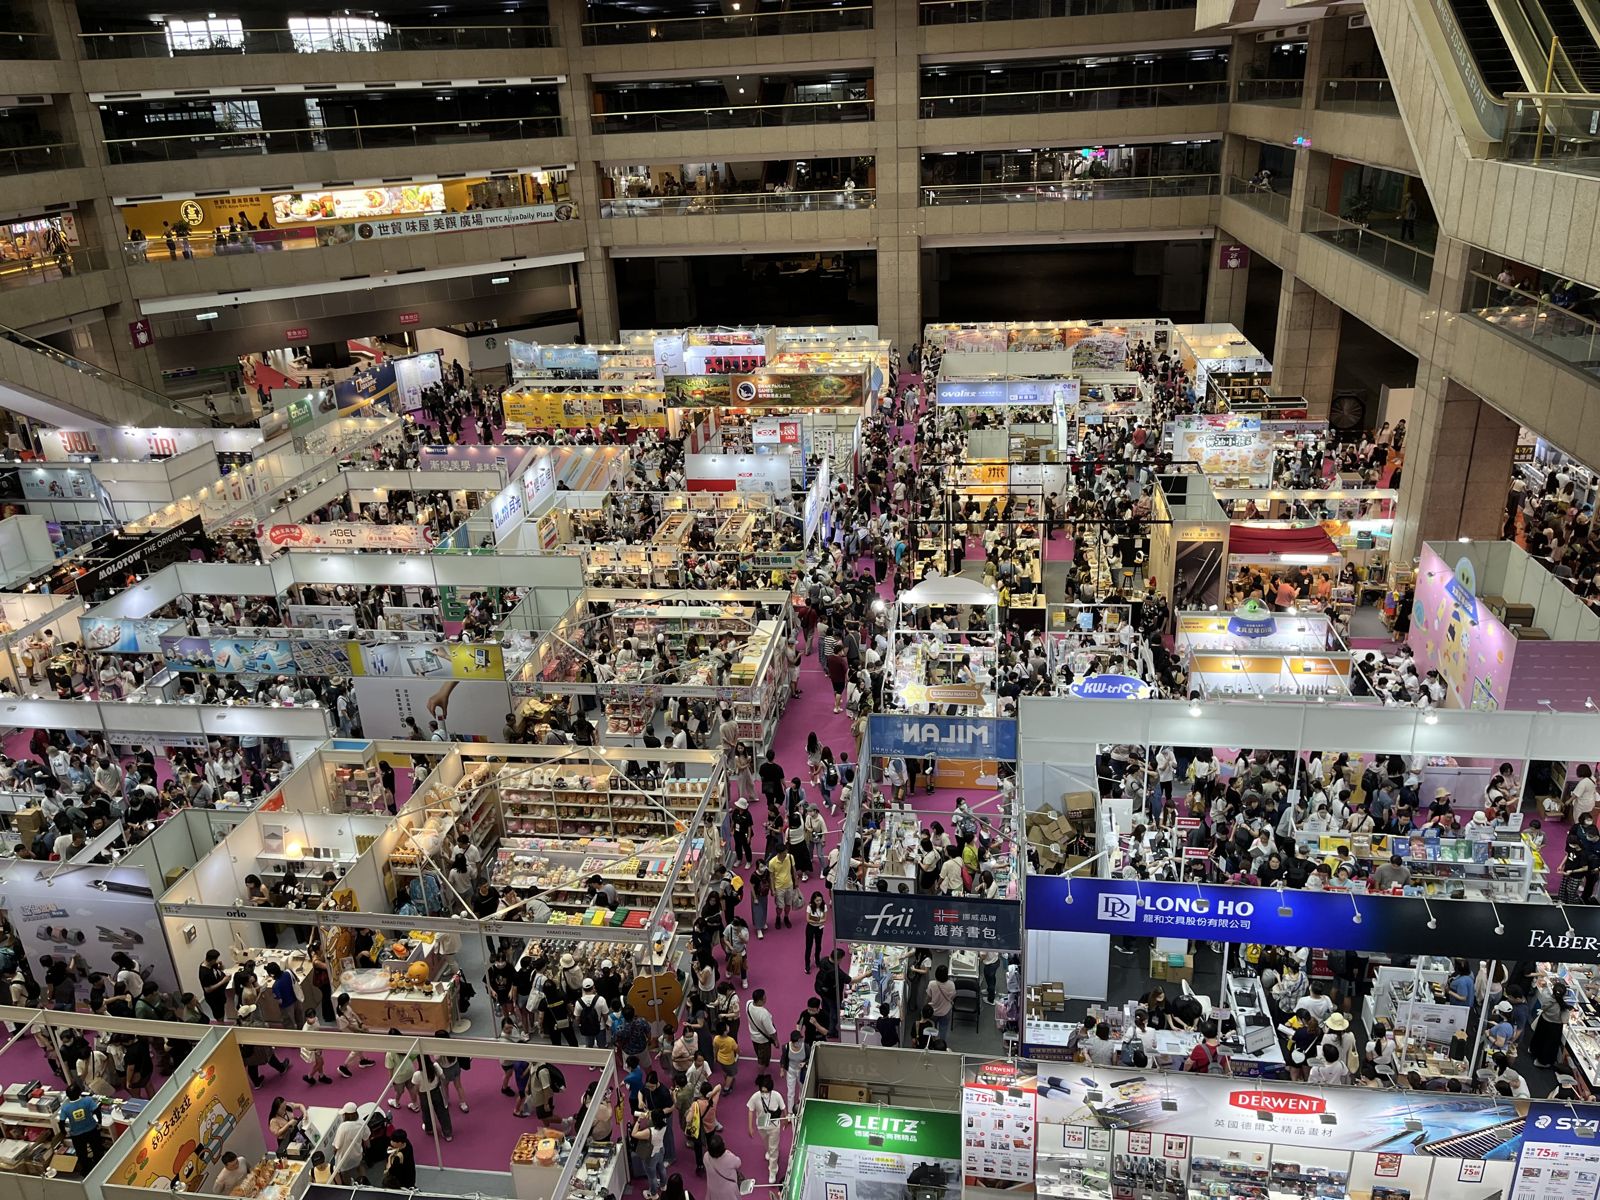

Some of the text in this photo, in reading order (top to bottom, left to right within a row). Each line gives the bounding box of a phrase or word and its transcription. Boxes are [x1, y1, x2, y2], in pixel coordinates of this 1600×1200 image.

[1451, 28, 1467, 65] IDEAS
[1465, 63, 1487, 113] ELEVATE
[486, 211, 553, 224] TWTC Ajiya Daily Plaza
[291, 404, 309, 419] cricut
[61, 431, 97, 454] JBL
[98, 528, 187, 580] MOLOTOW THE ORIGINAL
[227, 909, 247, 918] orlo
[1217, 900, 1254, 917] HO
[864, 903, 914, 936] frii
[962, 912, 997, 922] 挪威品牌
[883, 928, 927, 936] NORWAY
[934, 924, 997, 940] 護脊書包
[985, 1065, 1014, 1073] DERWENT
[1238, 1094, 1319, 1111] DERWENT
[854, 1115, 920, 1133] LEITZ
[1536, 1148, 1560, 1158] 75折
